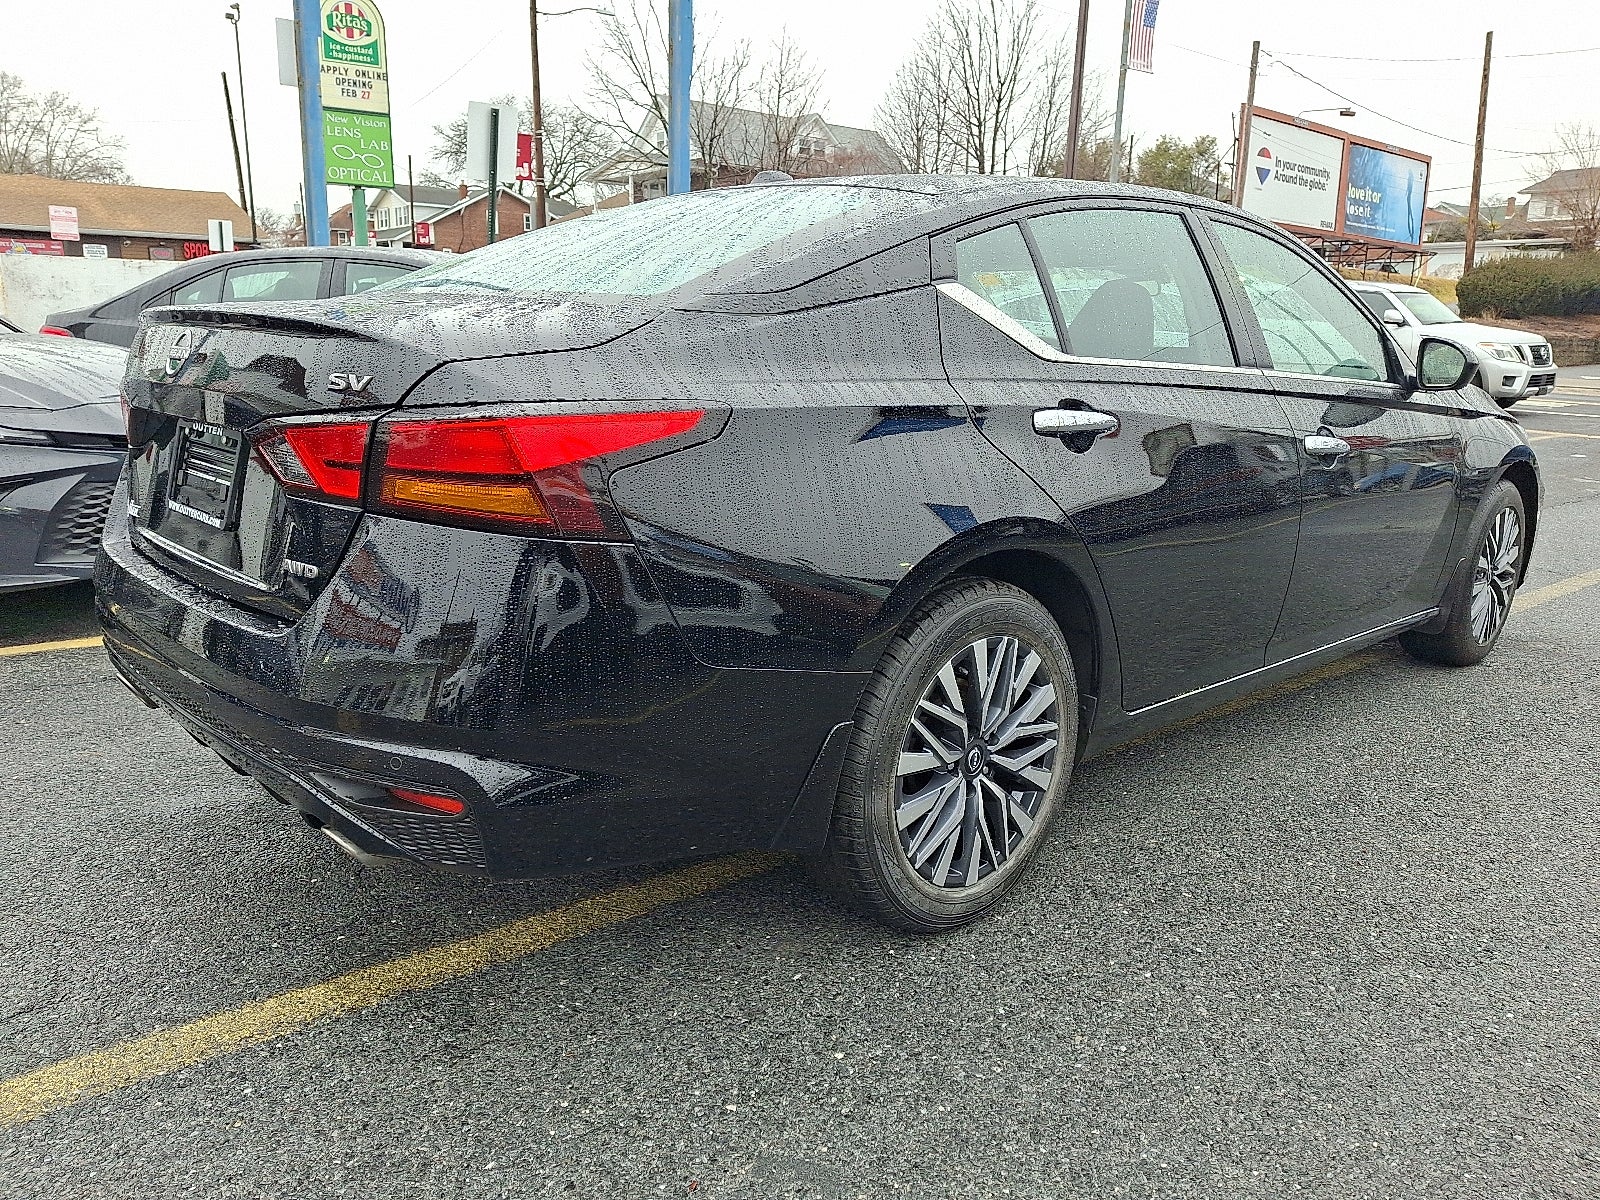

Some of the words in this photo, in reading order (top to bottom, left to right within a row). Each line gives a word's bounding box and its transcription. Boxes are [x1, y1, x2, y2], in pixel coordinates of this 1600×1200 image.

[332, 11, 368, 31] Rita's
[320, 64, 349, 76] APPLY
[355, 69, 388, 80] ONLINE
[335, 77, 373, 90] OPENING
[341, 88, 357, 98] FEB
[361, 90, 371, 100] 27
[326, 113, 349, 123] New
[353, 116, 387, 128] Vision
[326, 125, 362, 139] LENS
[360, 138, 389, 151] LAB
[1275, 155, 1282, 169] In
[1282, 160, 1297, 172] your
[327, 166, 391, 183] OPTICAL
[1273, 169, 1299, 186] Around
[1298, 175, 1309, 189] the
[1348, 182, 1364, 201] love
[1365, 186, 1373, 202] it
[1372, 191, 1382, 204] or
[1346, 200, 1364, 217] lose
[1364, 203, 1371, 218] it
[327, 372, 374, 392] SV
[192, 422, 224, 436] OUTTEN
[282, 558, 319, 579] AWD
